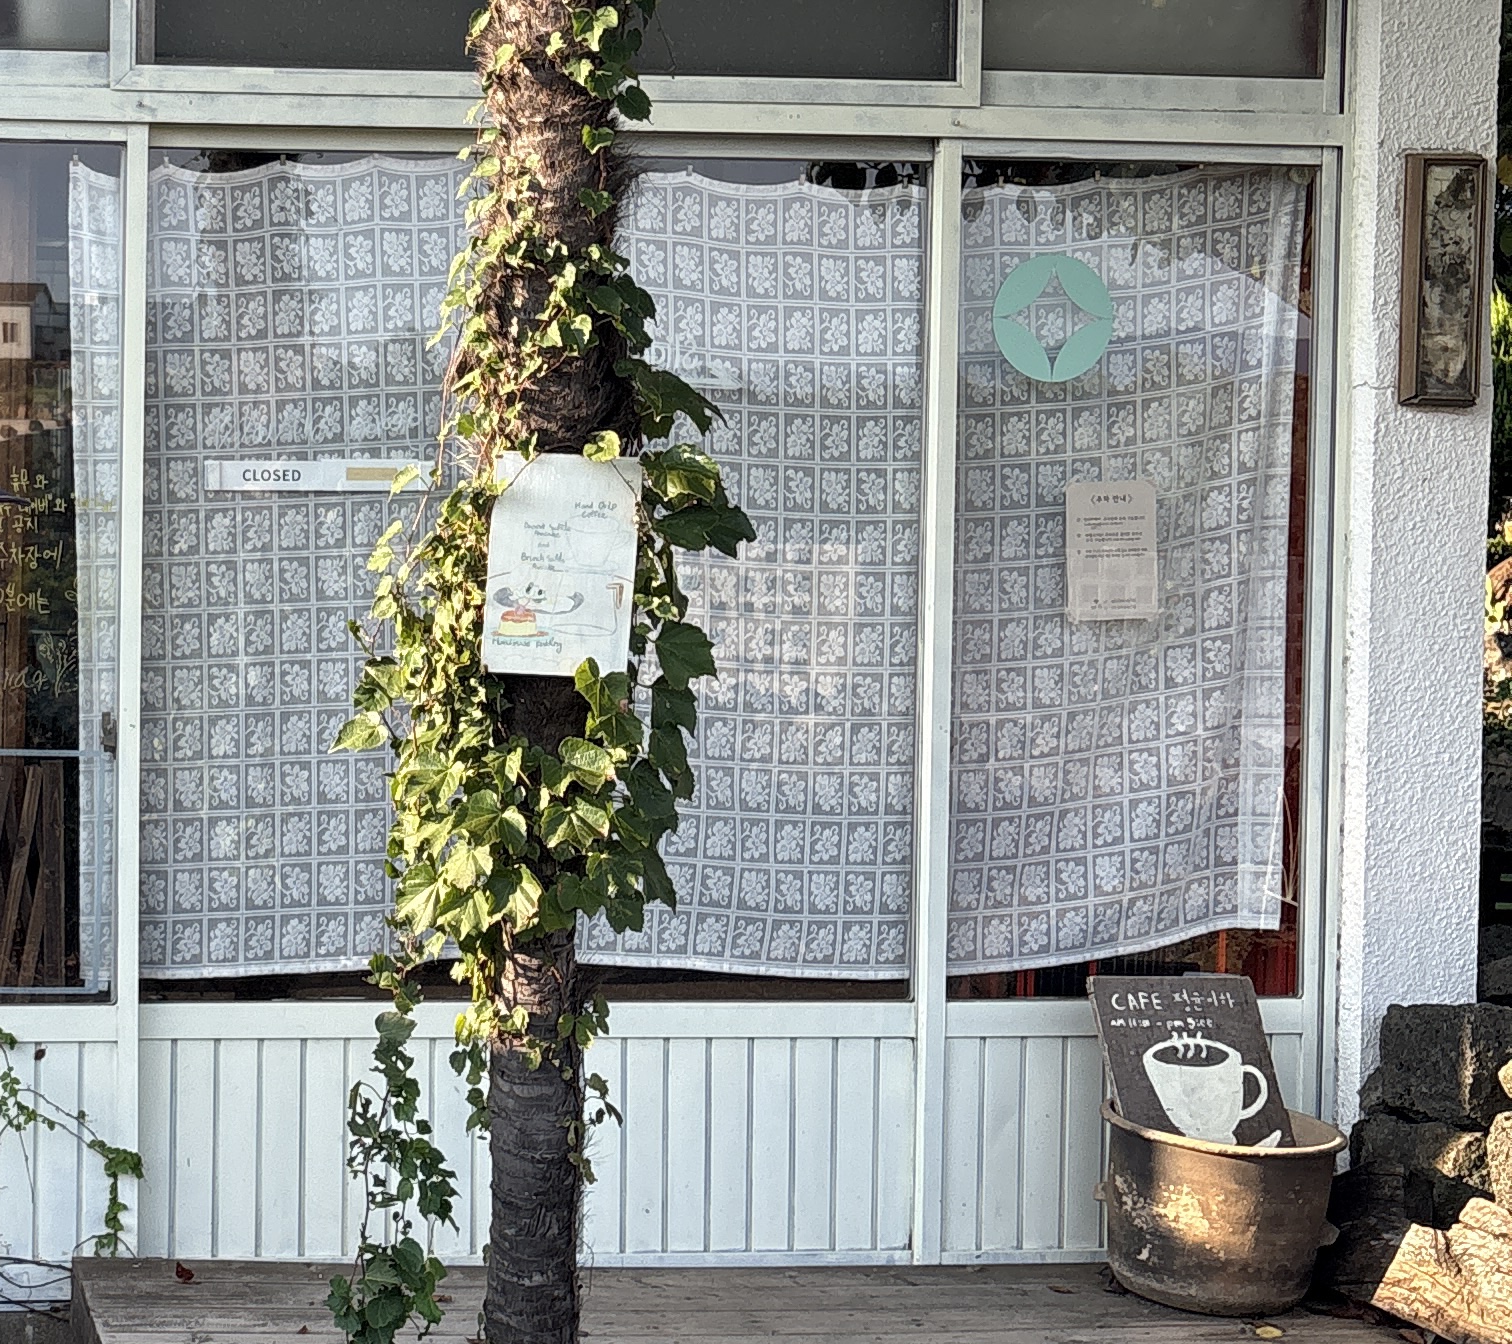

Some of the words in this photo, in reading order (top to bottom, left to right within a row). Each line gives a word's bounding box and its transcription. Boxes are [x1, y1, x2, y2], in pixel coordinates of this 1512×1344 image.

[242, 468, 302, 482] CLOSED
[12, 515, 39, 534] 공지
[1110, 991, 1164, 1011] CAFE
